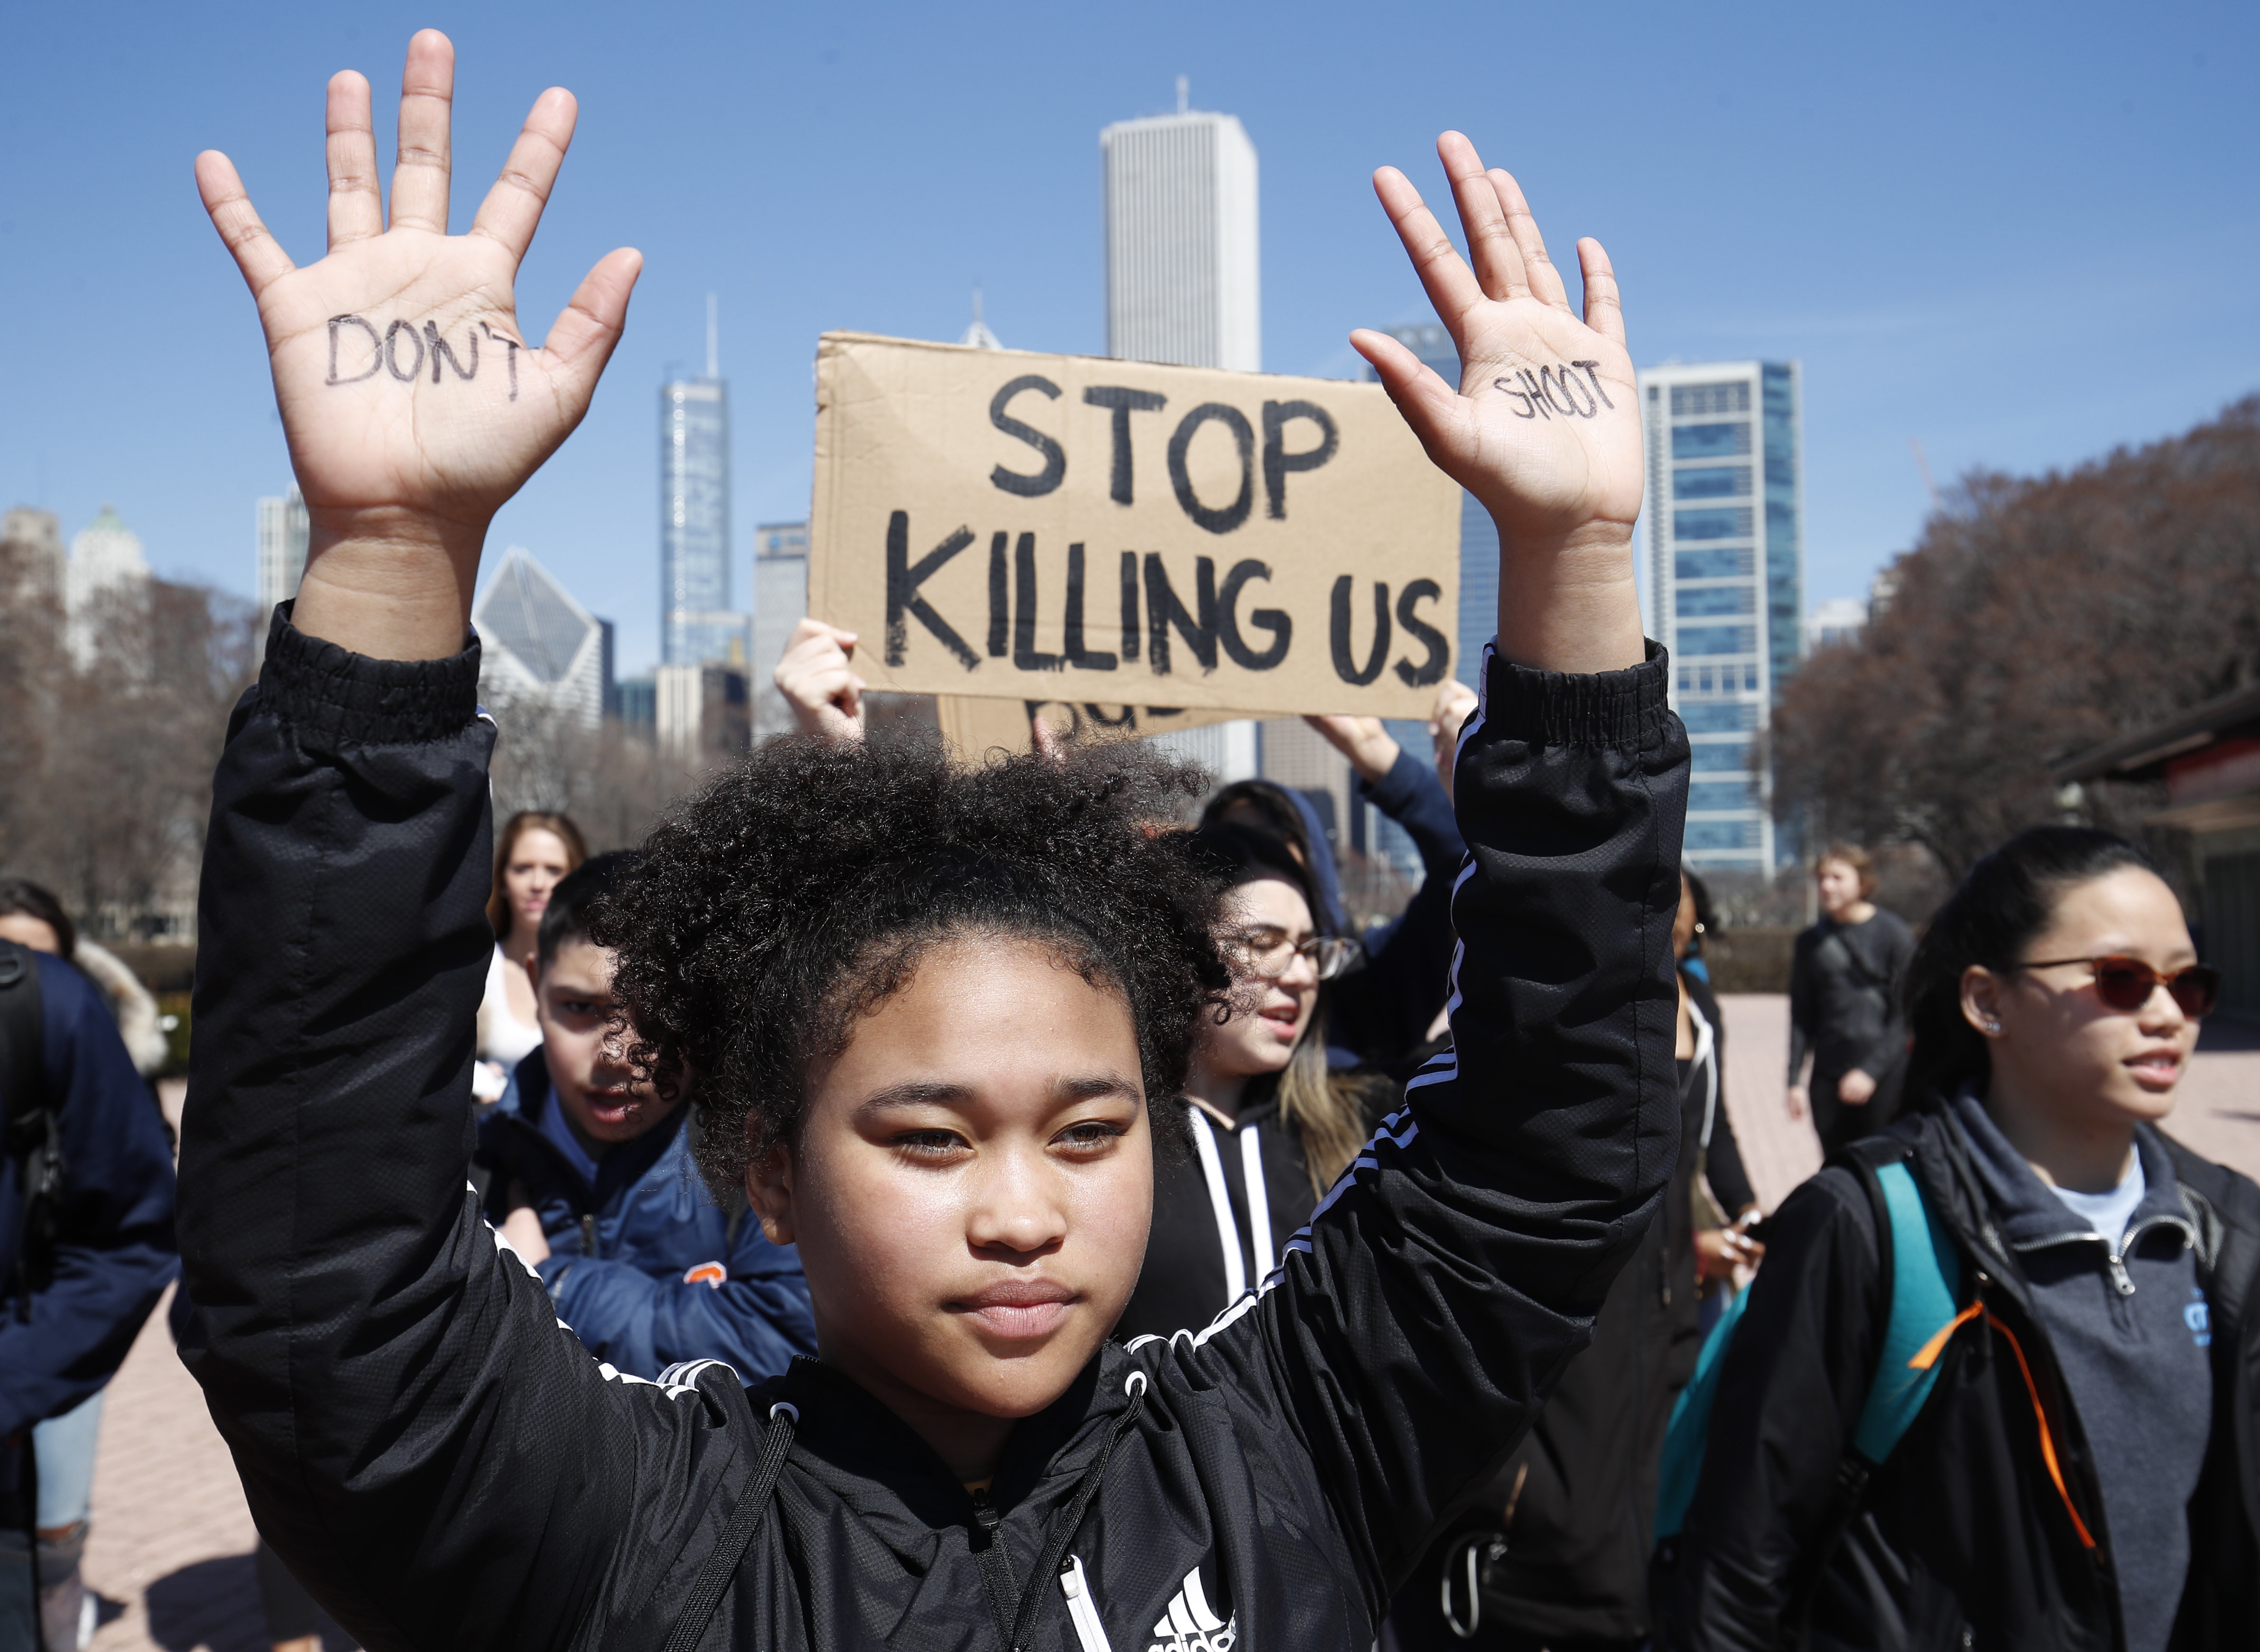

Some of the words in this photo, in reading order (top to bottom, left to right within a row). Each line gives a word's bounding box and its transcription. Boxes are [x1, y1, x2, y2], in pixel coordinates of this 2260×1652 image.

[325, 314, 521, 401] DON'T
[1493, 360, 1615, 421] SHOOT
[989, 374, 1339, 534] STOP
[884, 509, 1292, 675] KILLING
[1330, 574, 1450, 689] US
